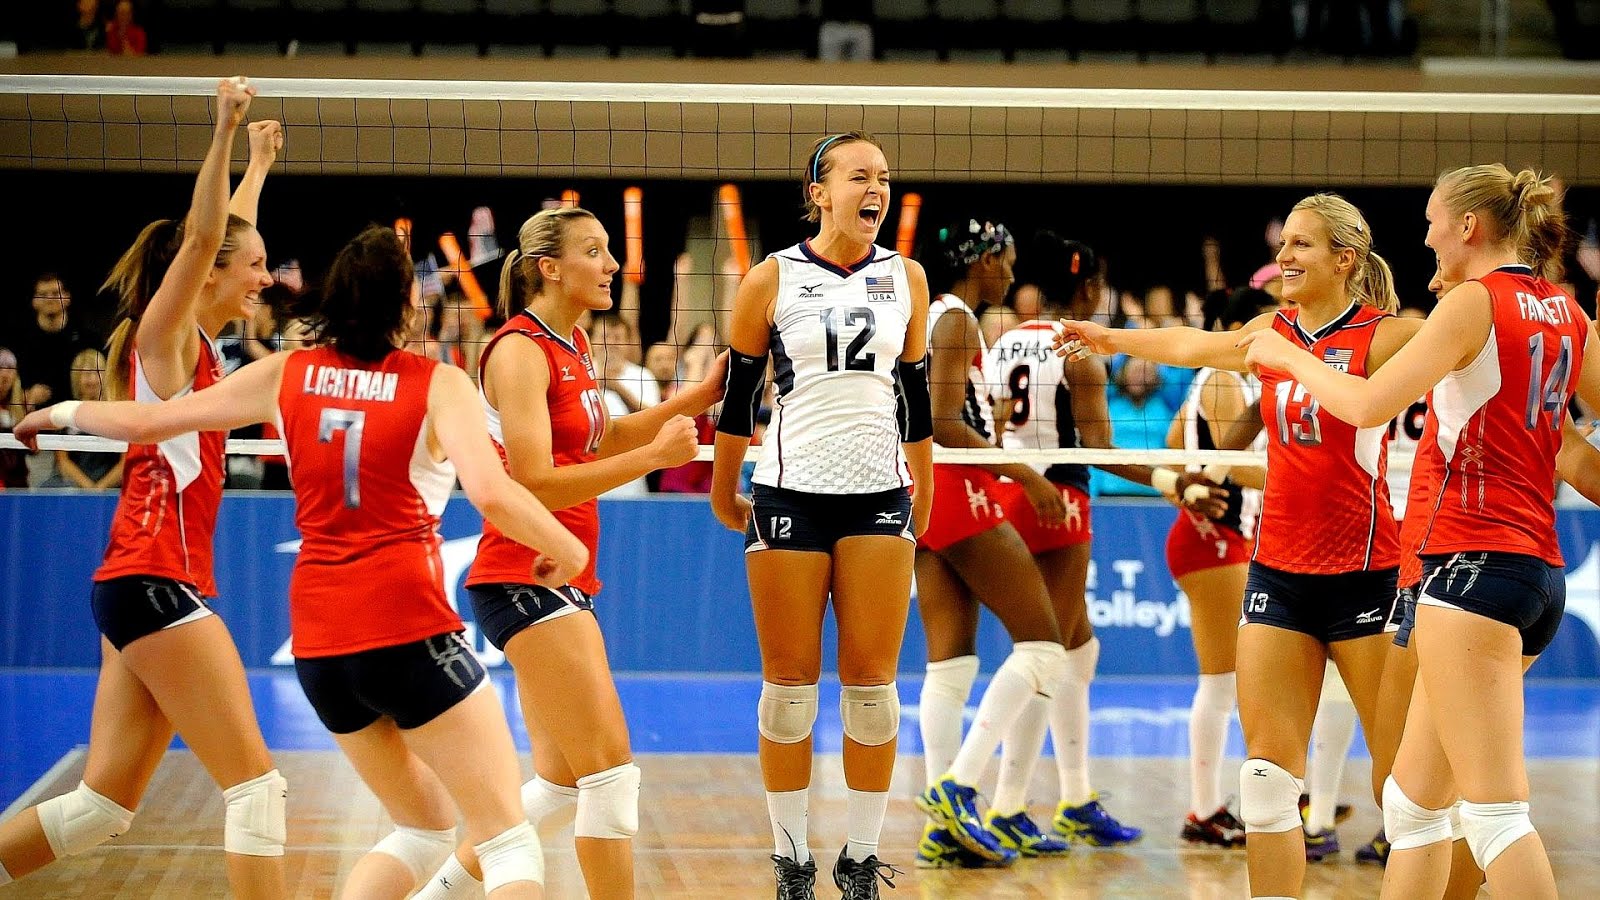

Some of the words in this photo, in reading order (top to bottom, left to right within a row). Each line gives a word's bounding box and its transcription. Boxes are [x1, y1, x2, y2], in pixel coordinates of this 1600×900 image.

[872, 293, 892, 301] USA
[820, 306, 876, 372] 12
[996, 341, 1053, 363] ARIAS
[1525, 331, 1572, 430] 14
[1275, 380, 1322, 446] 13
[319, 407, 366, 508] 7
[770, 516, 792, 540] 12
[1248, 592, 1269, 613] 13
